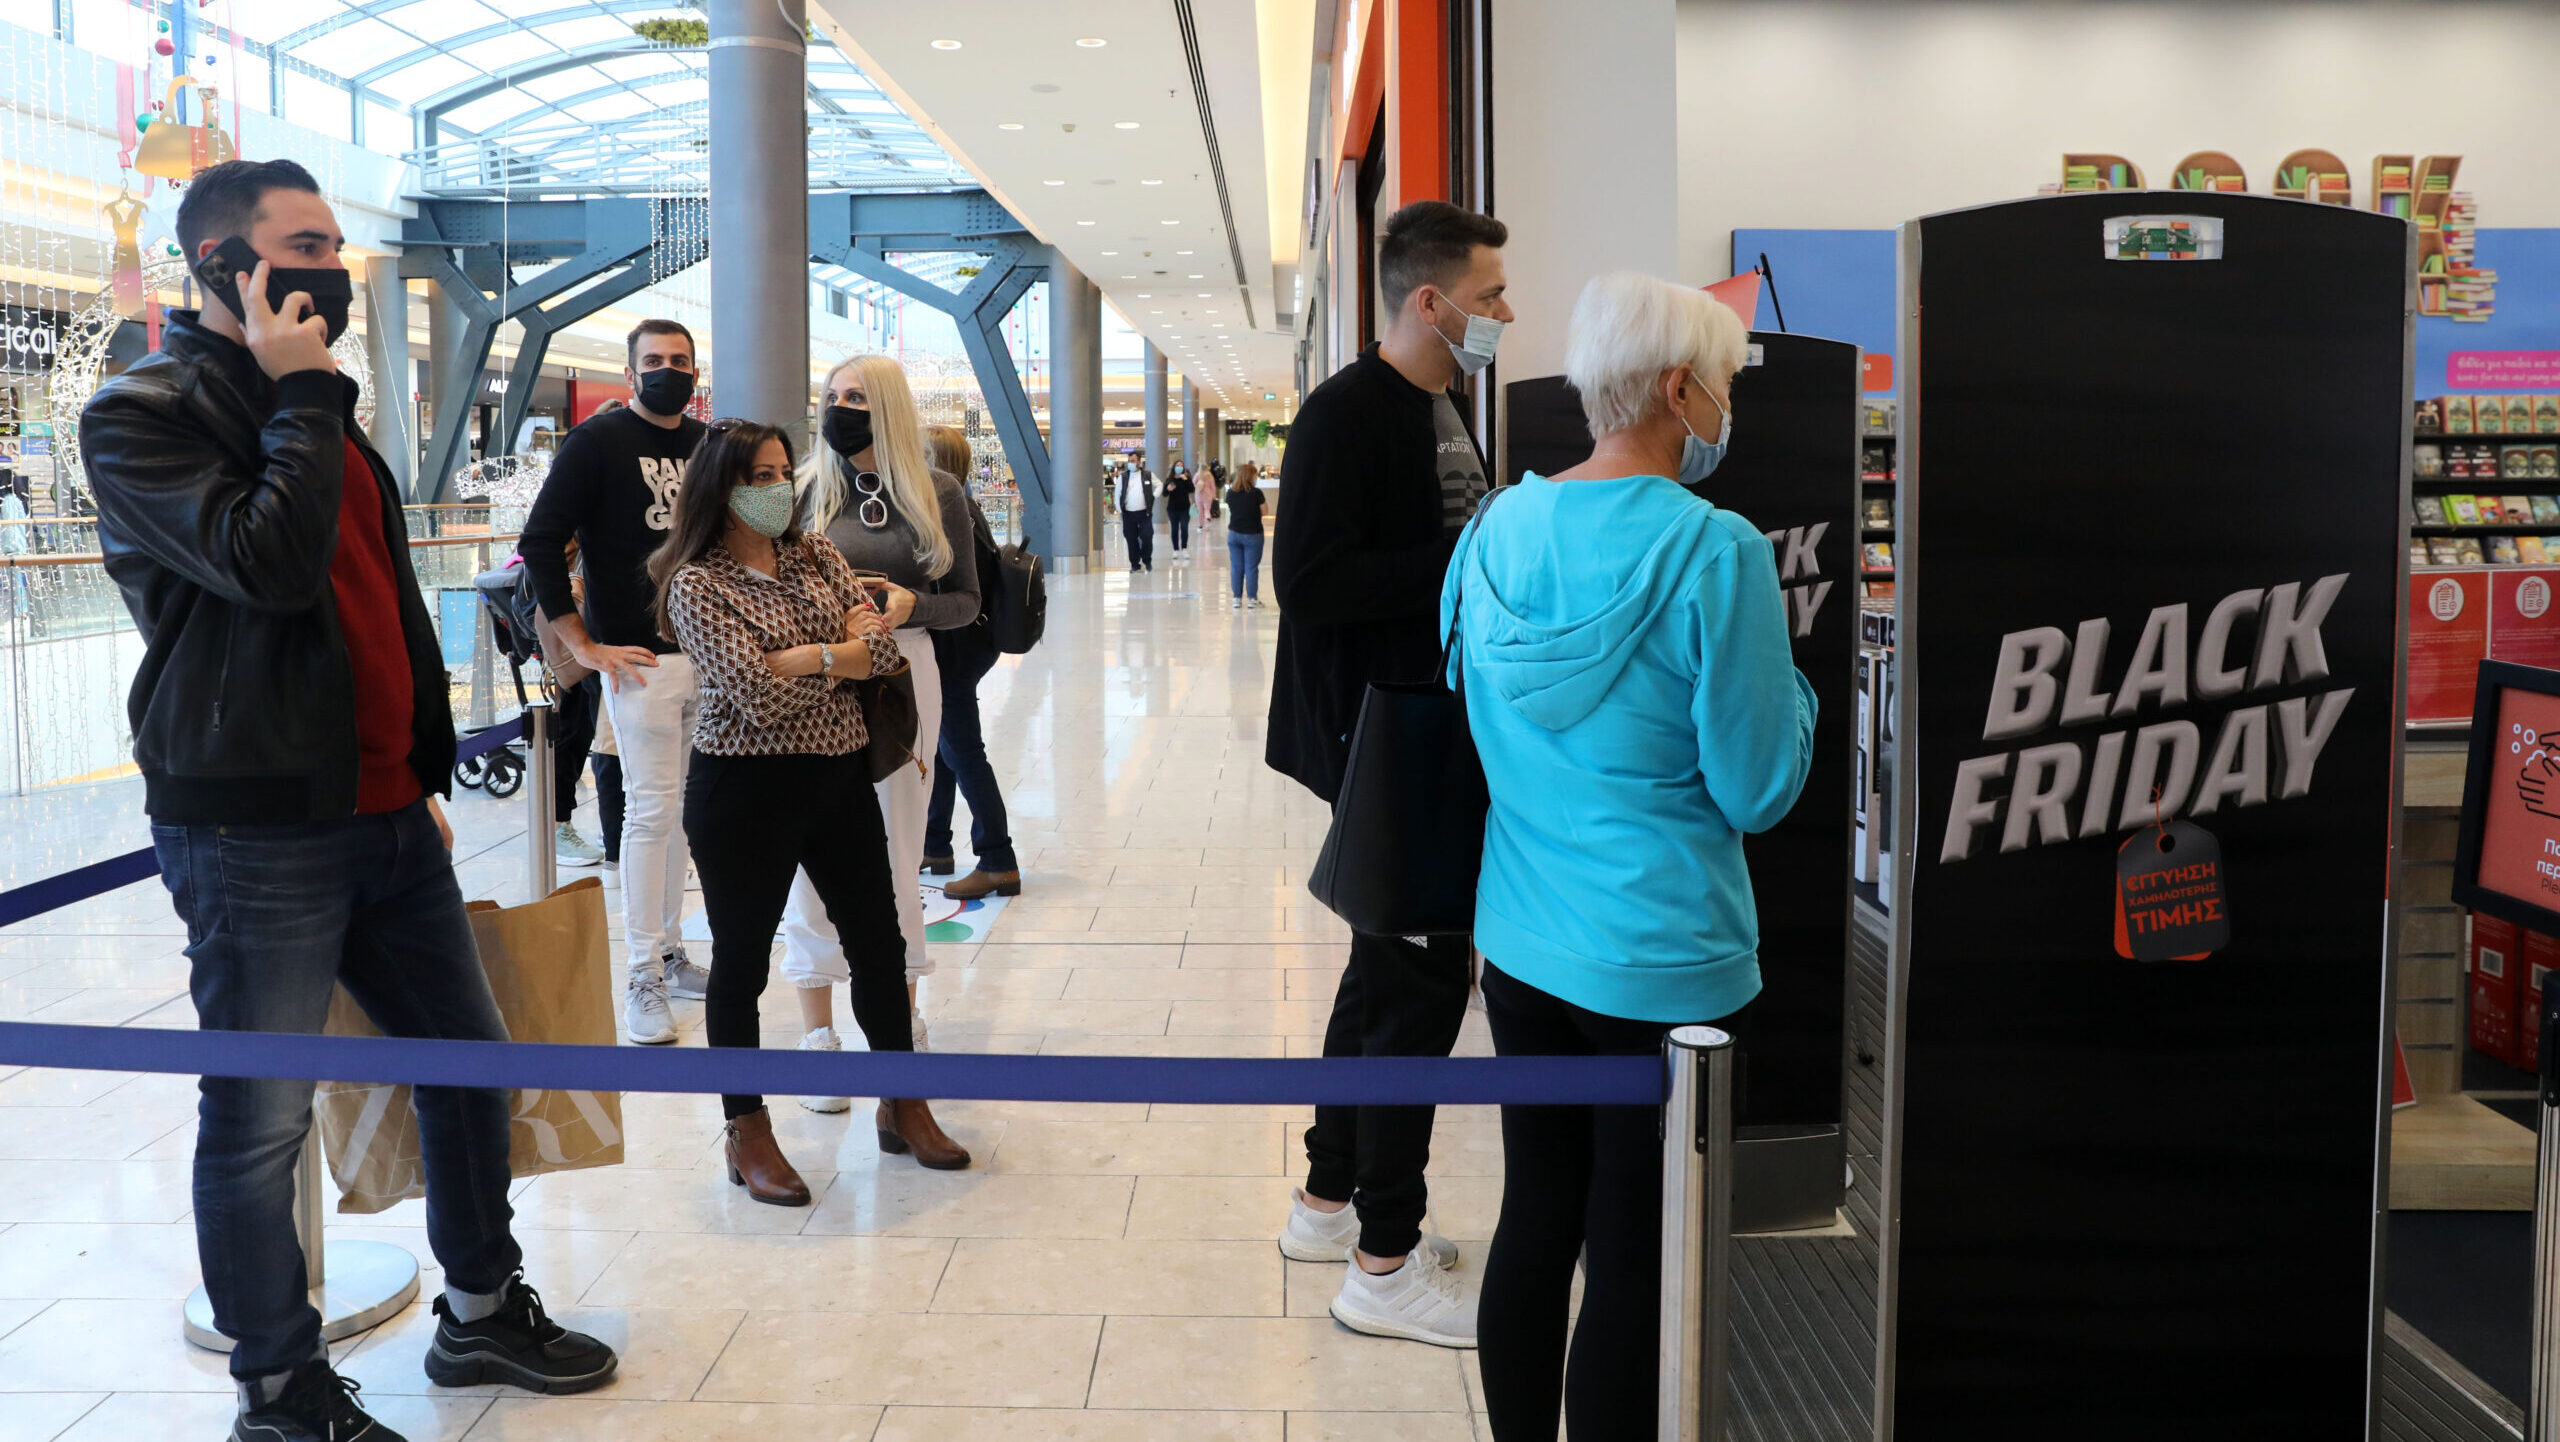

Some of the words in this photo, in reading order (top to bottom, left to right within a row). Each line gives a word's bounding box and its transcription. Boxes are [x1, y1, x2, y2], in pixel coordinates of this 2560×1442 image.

[638, 457, 688, 483] RAI
[1982, 572, 2351, 741] BLACK
[1939, 687, 2356, 864] FRIDAY
[2541, 878, 2560, 895] Ple
[2130, 898, 2223, 933] ΤΙΜΗΣ
